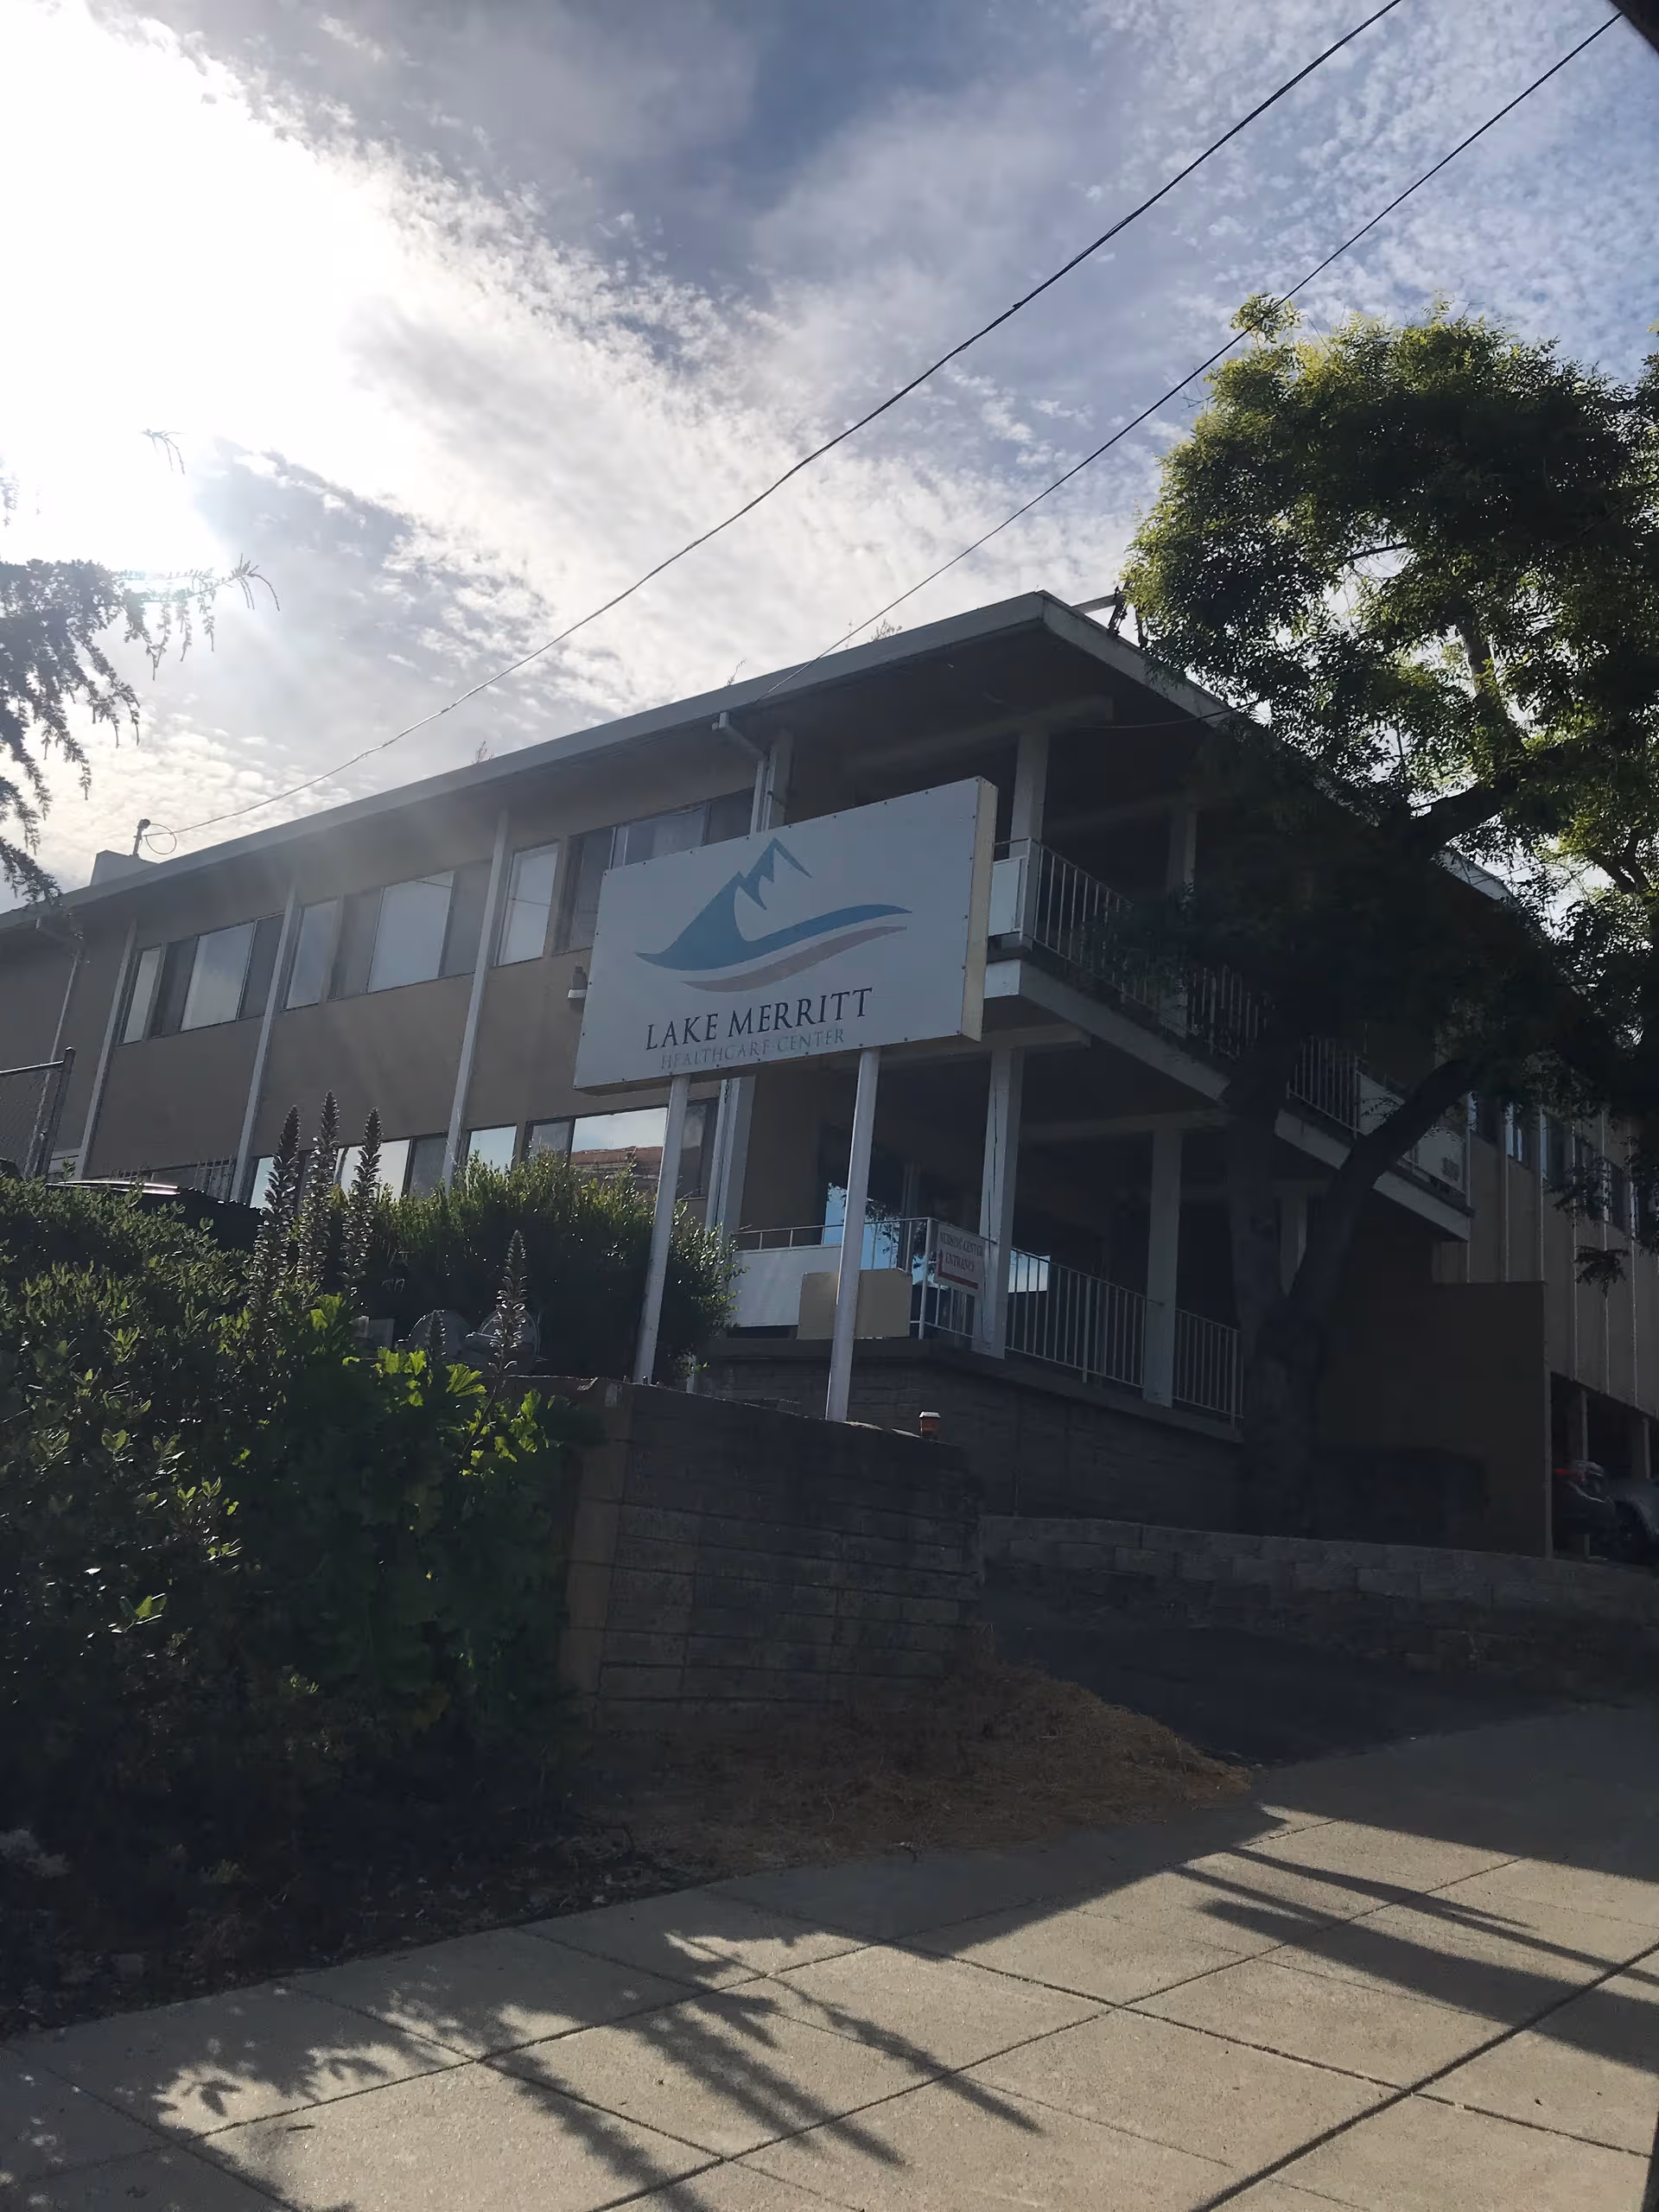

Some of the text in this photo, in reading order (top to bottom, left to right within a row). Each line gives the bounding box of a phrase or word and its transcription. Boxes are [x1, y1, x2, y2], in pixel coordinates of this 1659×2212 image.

[645, 988, 873, 1051] LAKE MERRITT
[661, 1028, 845, 1071] HEALTHCARE CENTER
